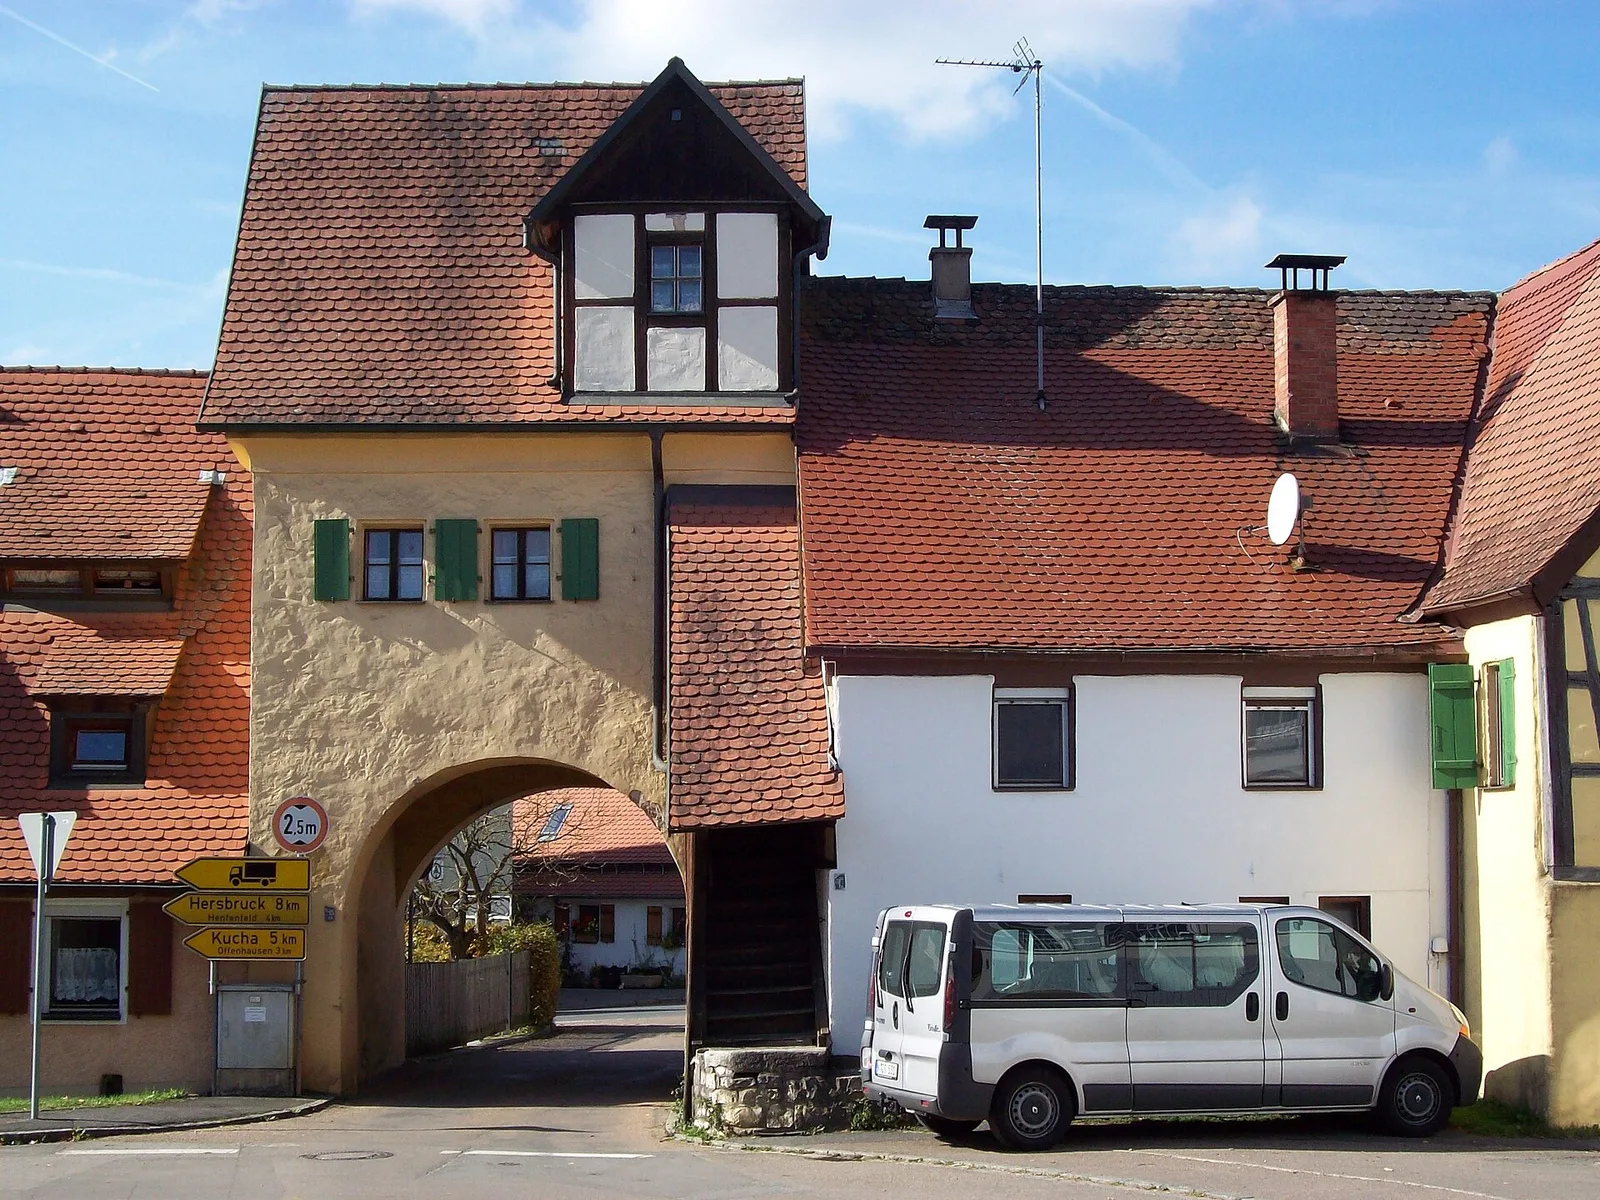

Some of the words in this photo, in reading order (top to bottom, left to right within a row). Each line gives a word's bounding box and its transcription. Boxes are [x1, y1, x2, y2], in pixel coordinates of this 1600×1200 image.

[283, 814, 317, 836] 2,5m
[189, 896, 266, 911] Hersbruck
[275, 897, 284, 911] 8
[286, 900, 300, 911] km
[211, 931, 259, 945] Kucha
[269, 931, 279, 945] 5
[282, 933, 297, 945] km
[217, 946, 273, 955] Offenhausen
[275, 946, 281, 955] 3
[282, 947, 292, 955] km
